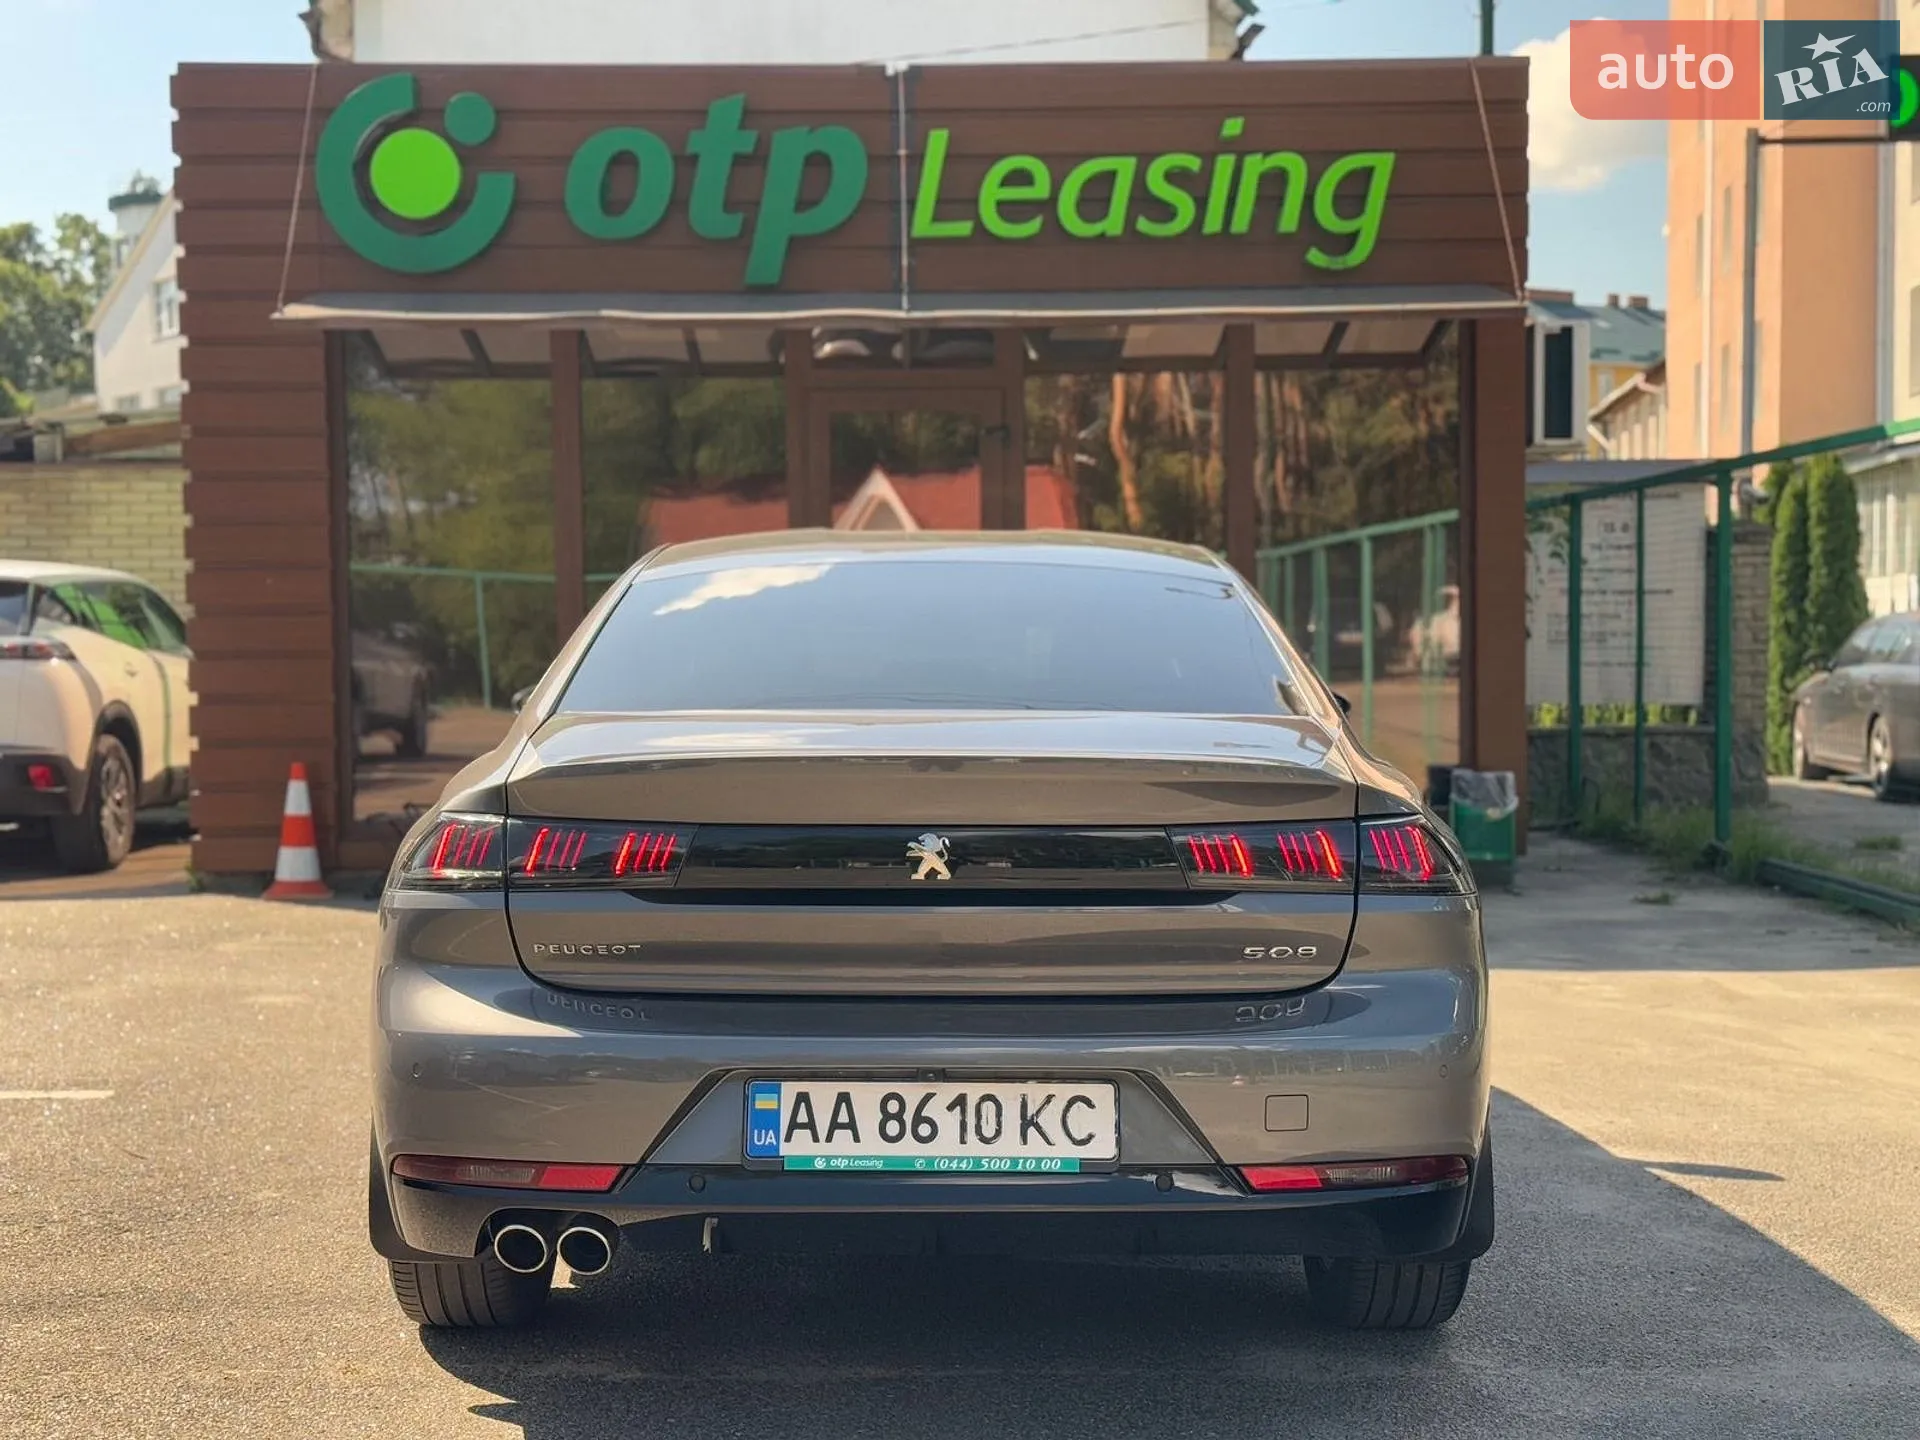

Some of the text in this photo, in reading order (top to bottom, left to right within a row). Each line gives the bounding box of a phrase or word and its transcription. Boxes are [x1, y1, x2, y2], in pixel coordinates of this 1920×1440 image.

[564, 92, 1396, 285] otp Leasing
[533, 943, 642, 955] PEUGEOT
[1243, 946, 1318, 960] 508
[784, 1091, 1096, 1147] AA 8610 KC
[754, 1128, 776, 1146] UA
[829, 1157, 849, 1169] otp
[934, 1158, 1062, 1171] (044) 500 10 00
